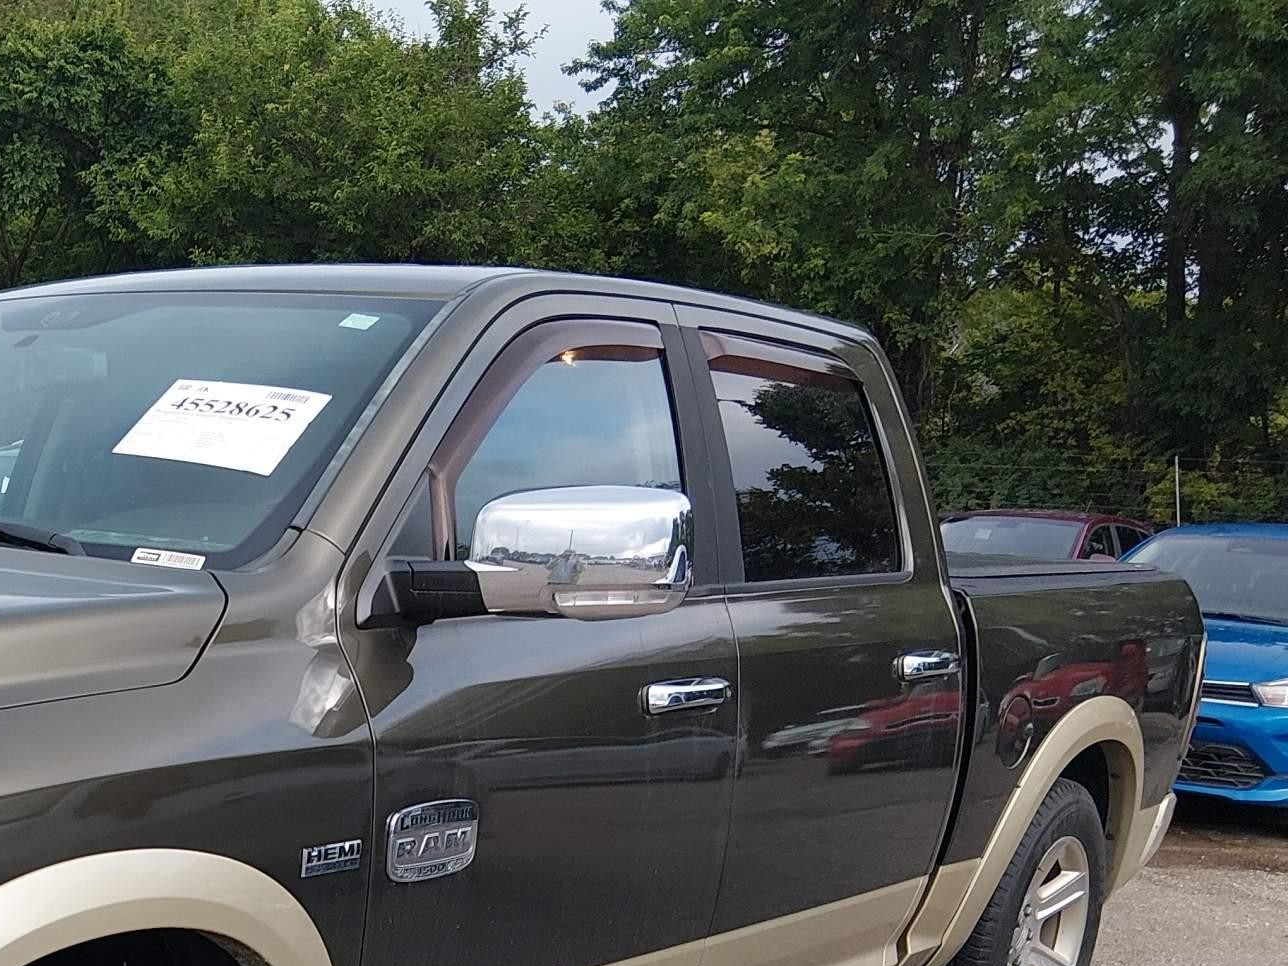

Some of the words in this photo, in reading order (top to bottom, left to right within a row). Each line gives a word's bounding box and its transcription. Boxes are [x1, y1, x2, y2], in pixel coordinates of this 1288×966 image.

[171, 397, 295, 422] 45528625
[306, 842, 361, 865] HEMI
[396, 826, 472, 859] RAM
